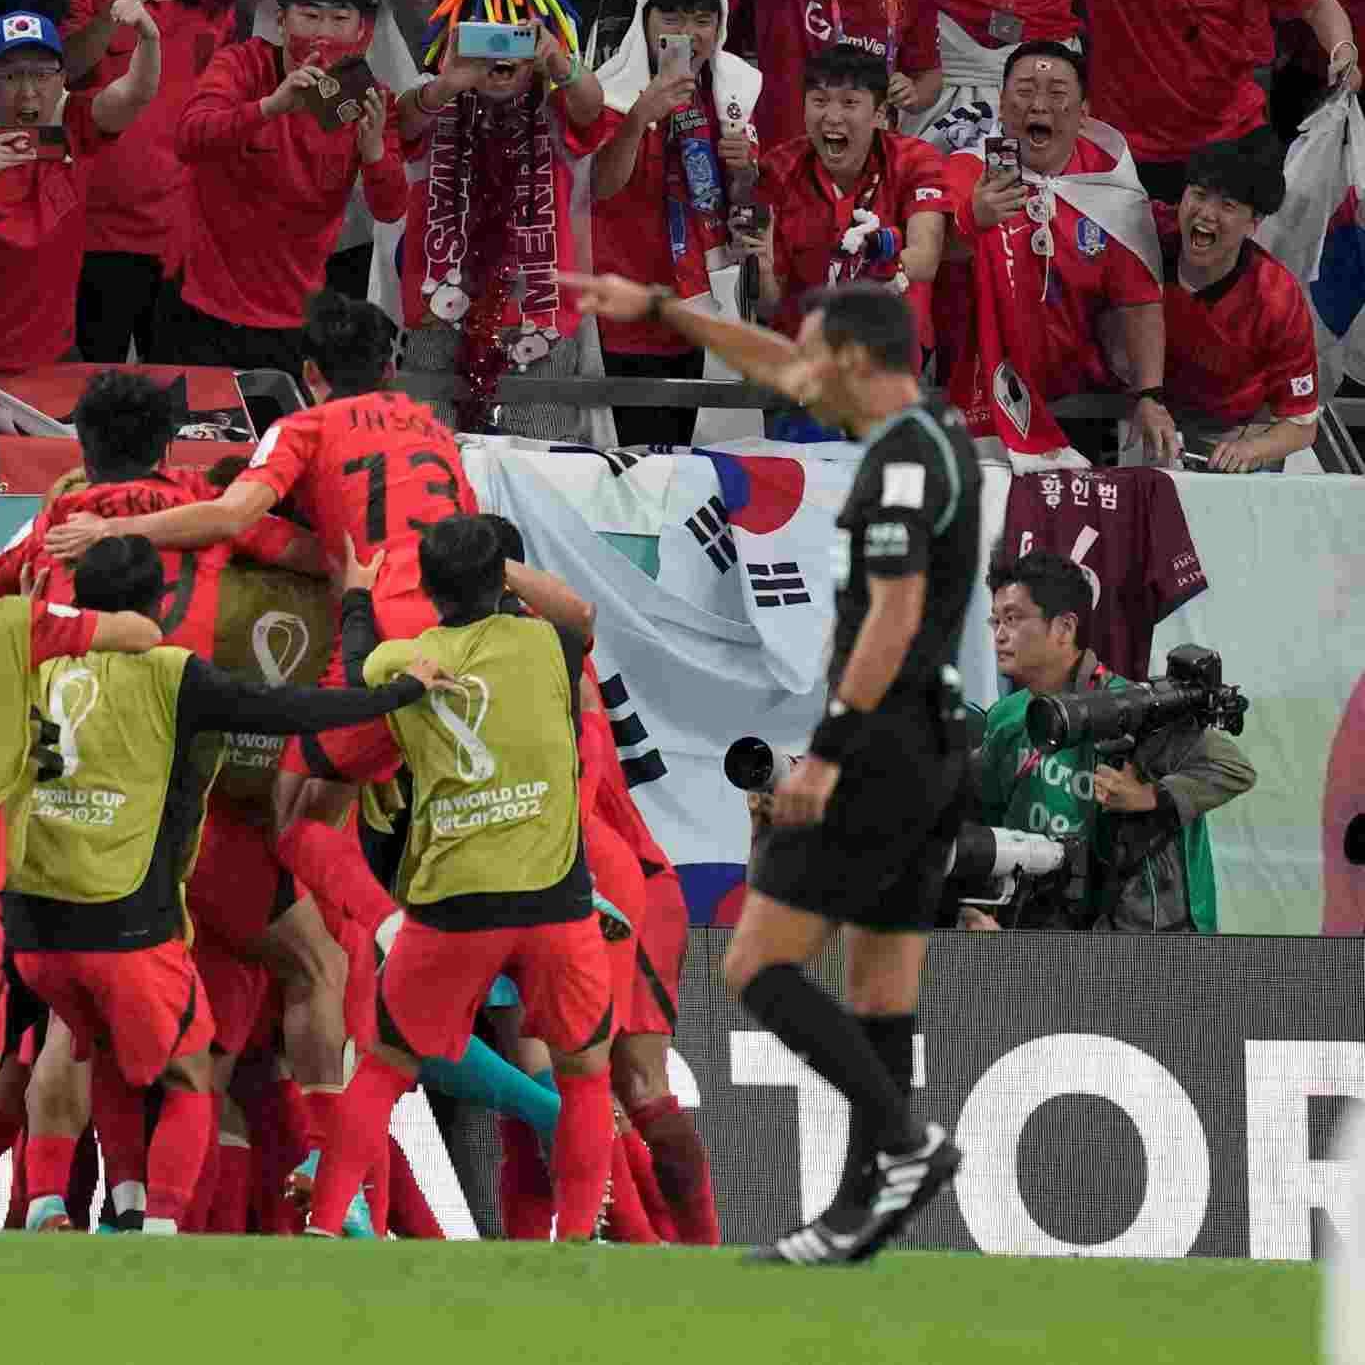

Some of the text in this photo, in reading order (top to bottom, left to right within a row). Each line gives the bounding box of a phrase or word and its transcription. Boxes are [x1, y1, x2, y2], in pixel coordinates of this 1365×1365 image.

[343, 452, 460, 542] 13
[90, 791, 126, 807] CUP
[454, 788, 512, 813] WORLD
[514, 780, 550, 801] CUP
